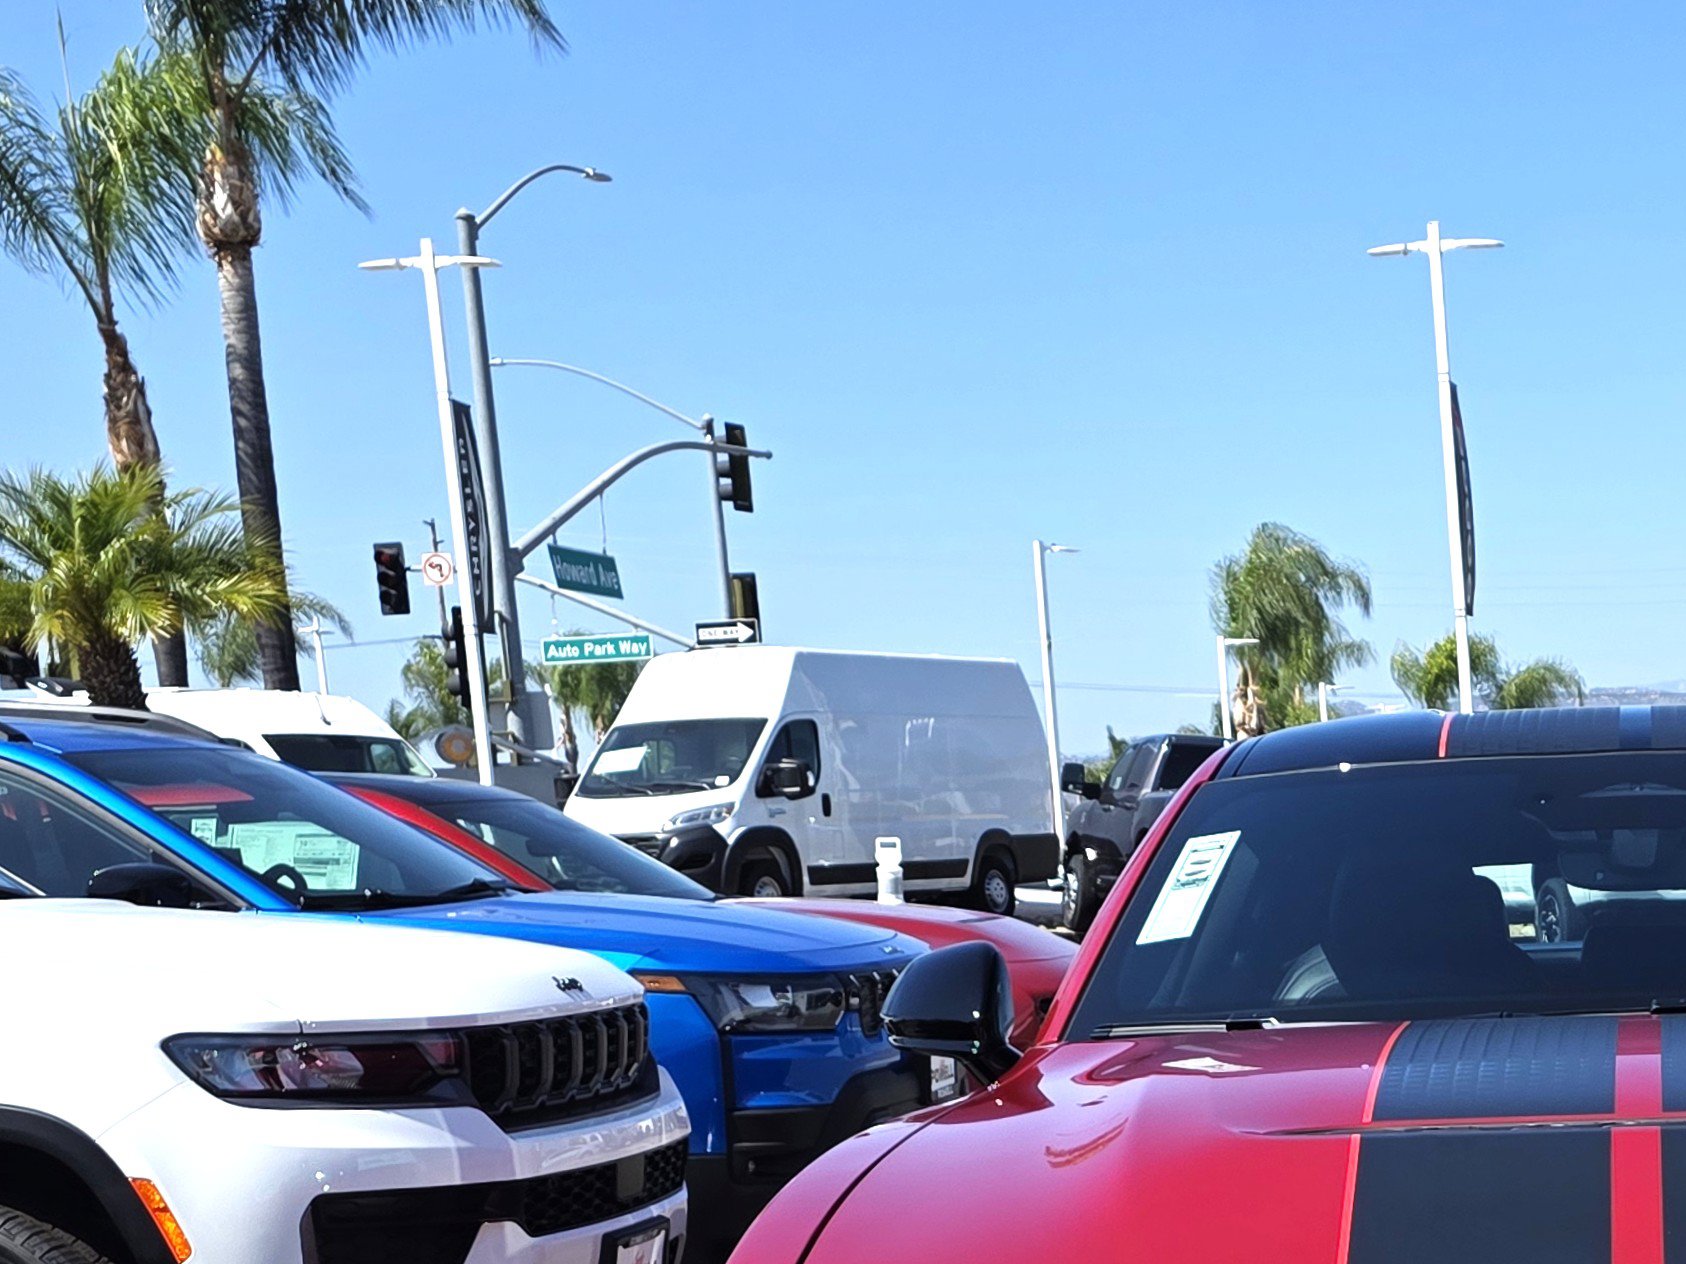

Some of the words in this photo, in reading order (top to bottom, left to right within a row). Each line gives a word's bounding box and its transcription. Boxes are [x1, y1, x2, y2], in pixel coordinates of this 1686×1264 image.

[553, 554, 598, 587] Howard
[598, 562, 619, 590] Ave
[547, 643, 580, 659] Auto
[583, 641, 616, 656] Park
[618, 639, 648, 655] Way
